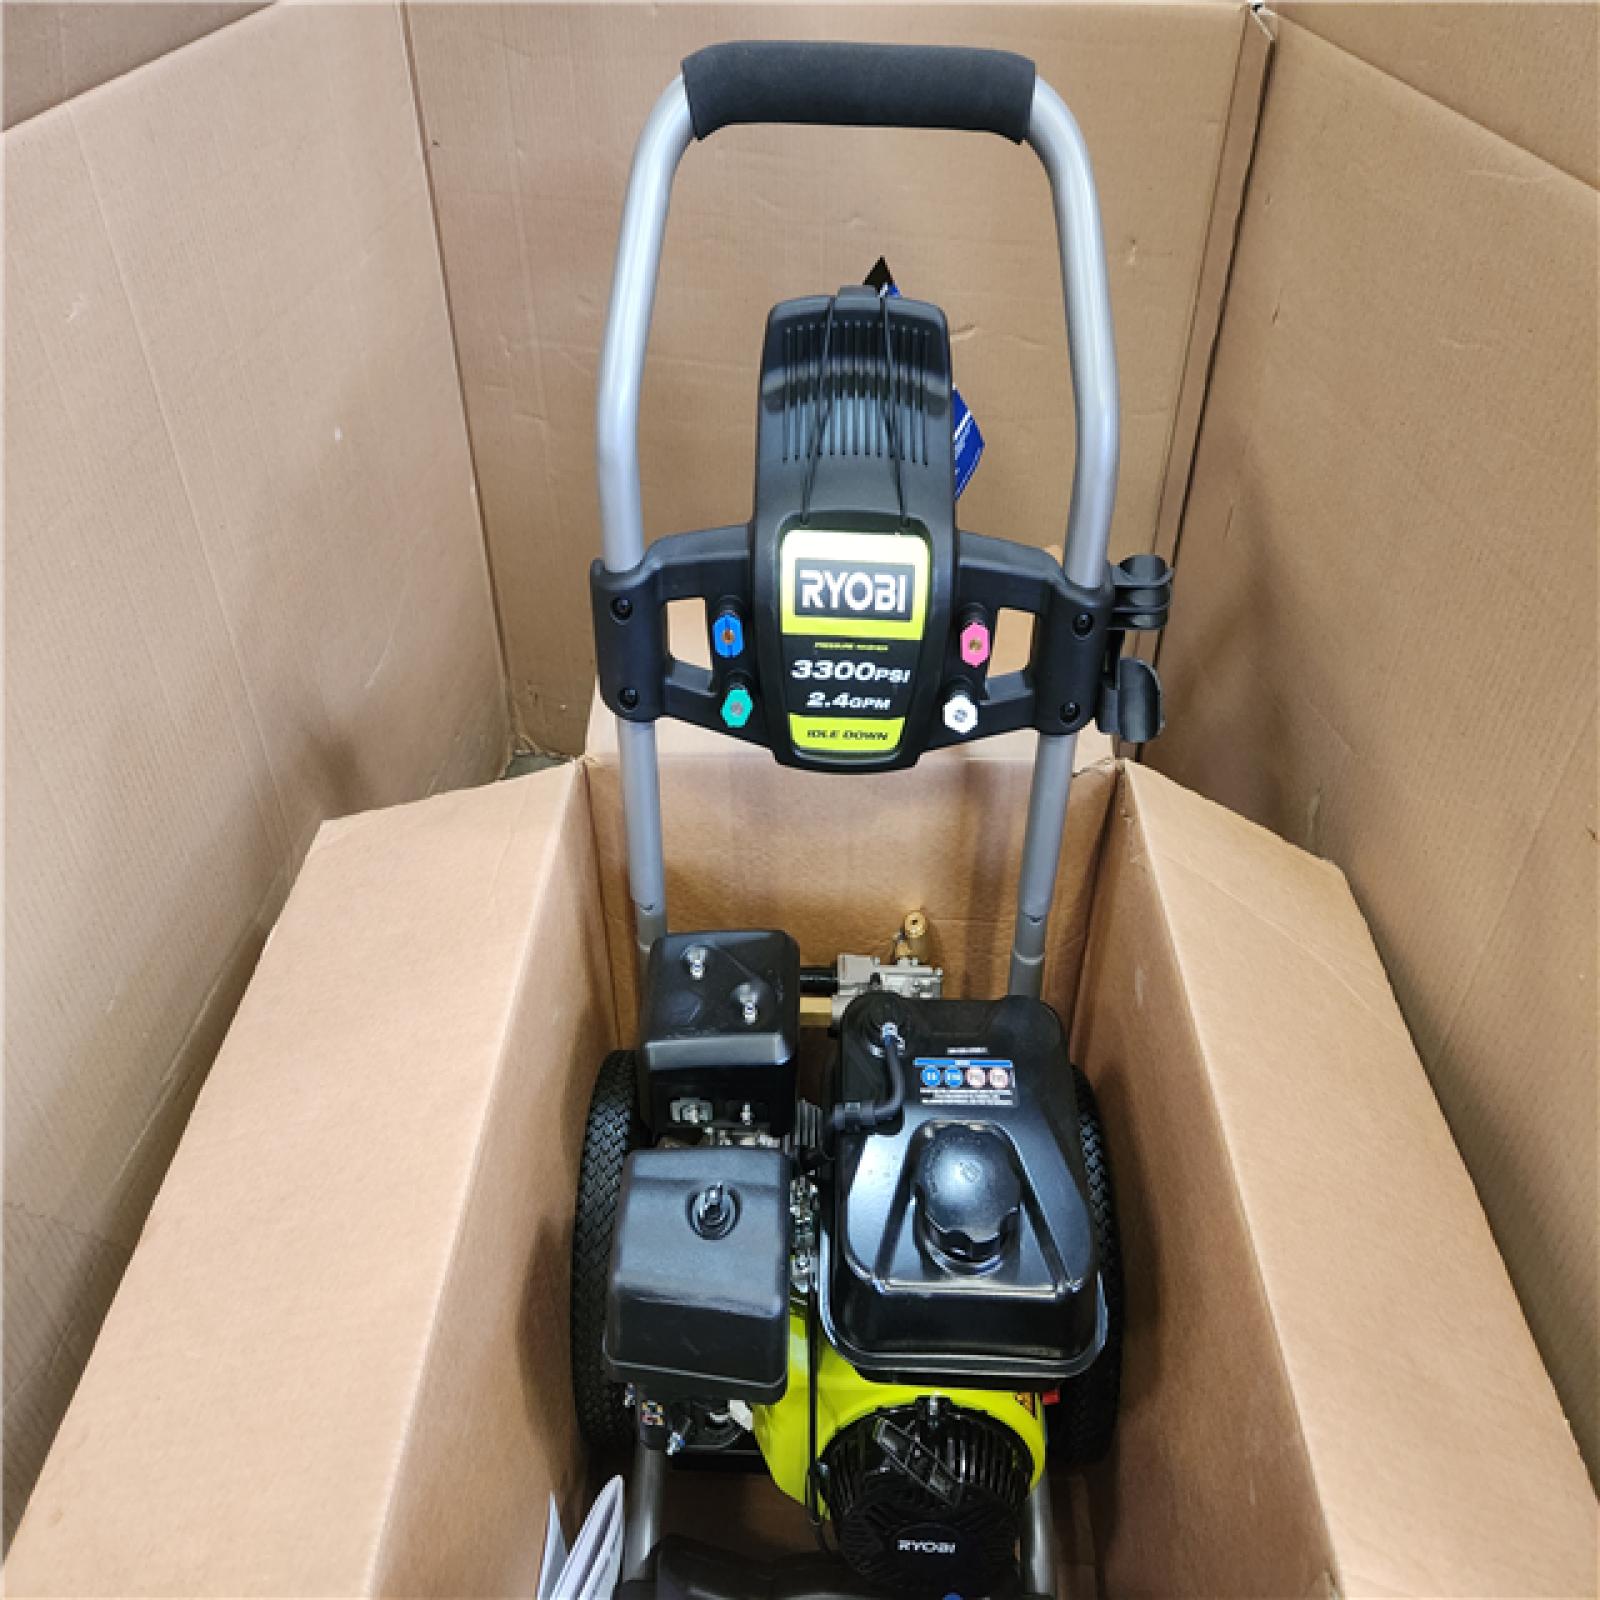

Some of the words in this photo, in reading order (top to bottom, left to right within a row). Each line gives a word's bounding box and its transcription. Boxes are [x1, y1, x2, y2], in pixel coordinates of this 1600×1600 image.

[799, 568, 906, 613] RYOBI
[842, 730, 889, 741] DOWN
[897, 1539, 956, 1553] RYOBI
